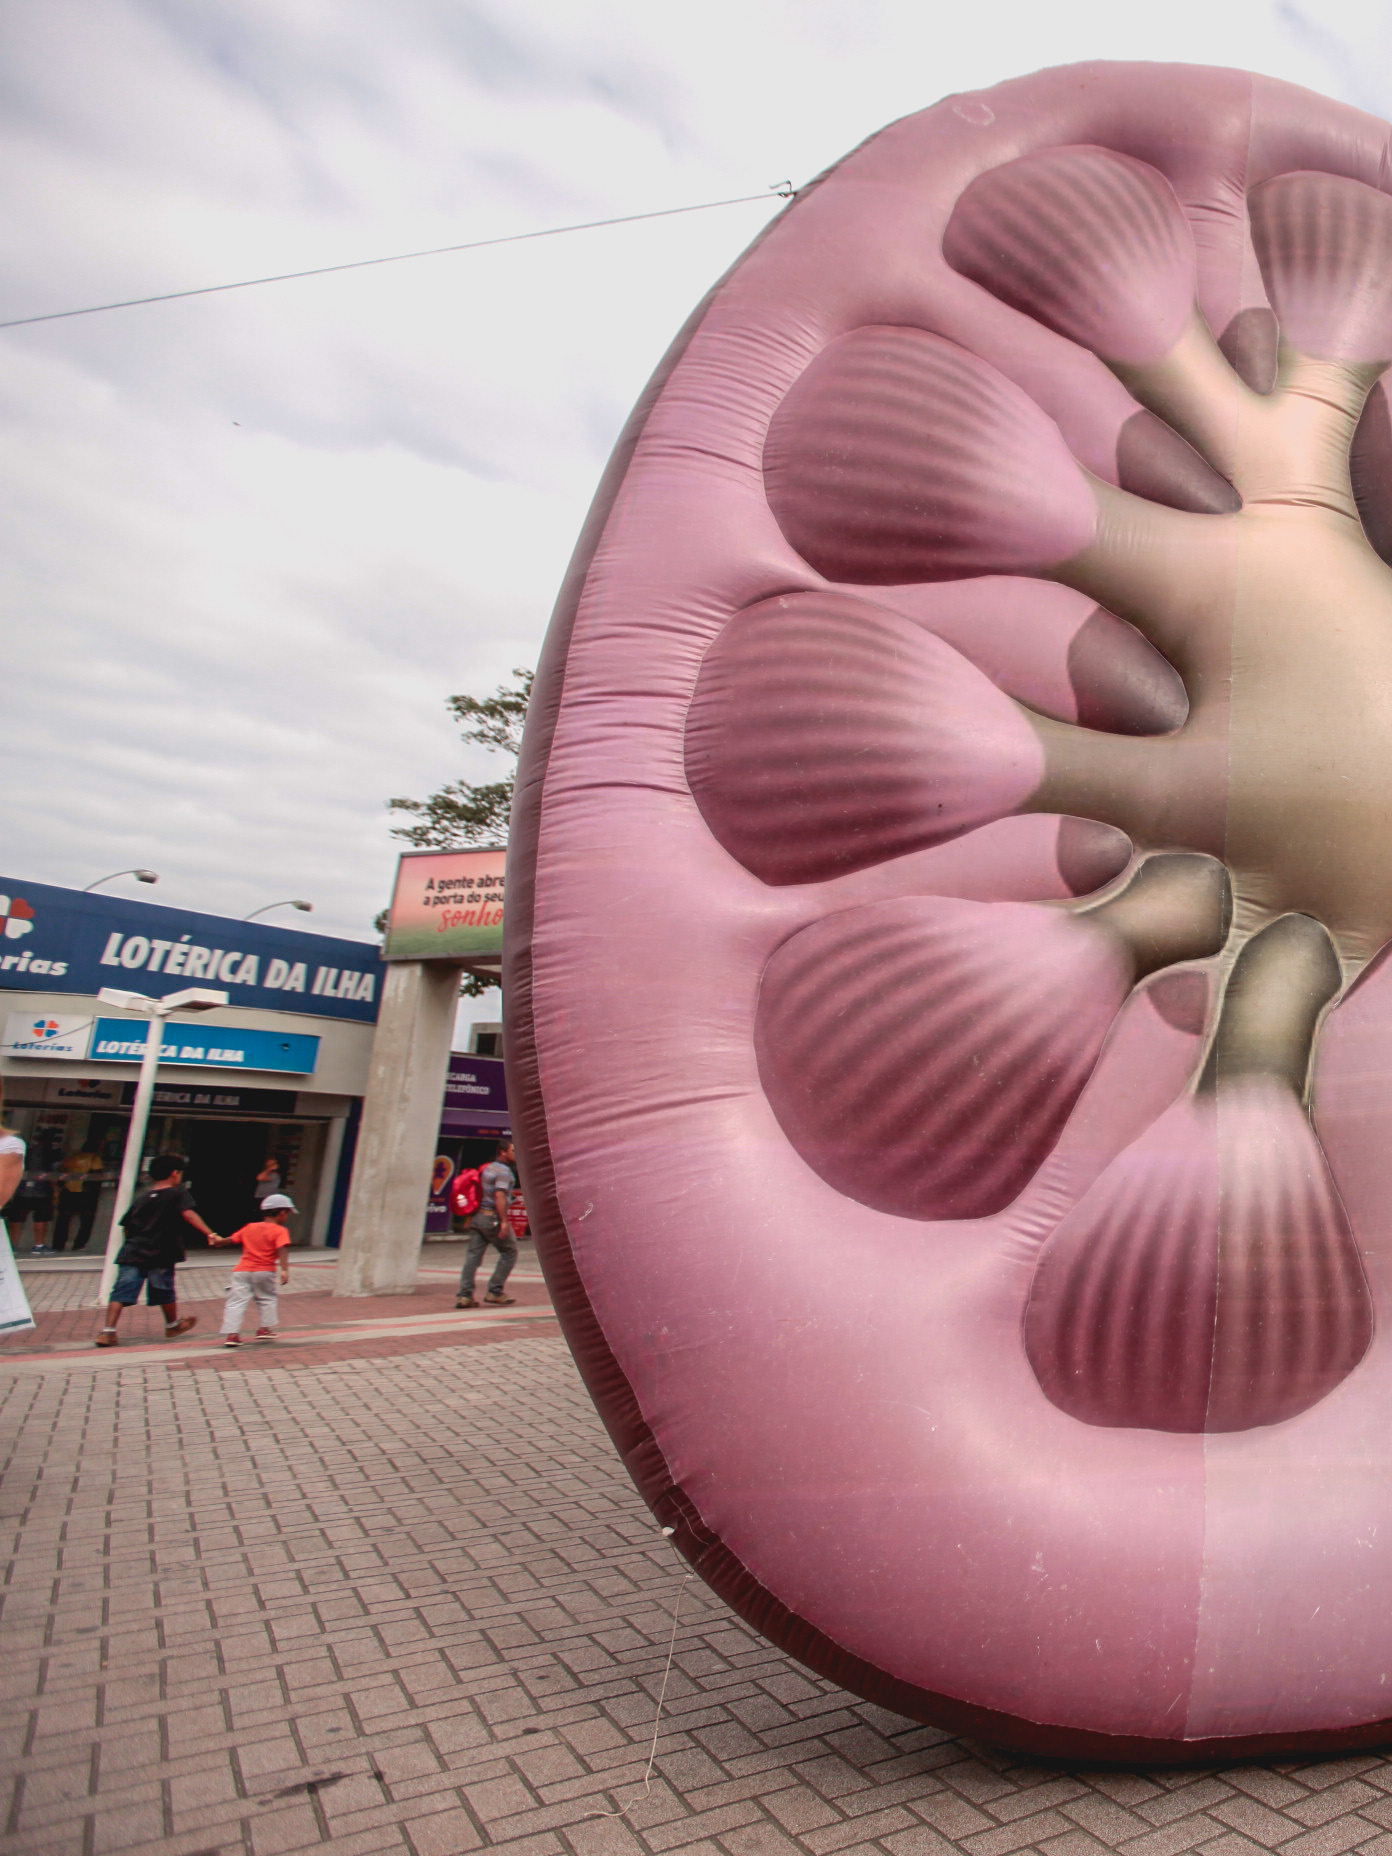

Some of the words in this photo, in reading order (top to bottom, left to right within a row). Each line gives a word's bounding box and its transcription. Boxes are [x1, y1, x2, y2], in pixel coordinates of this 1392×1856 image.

[425, 877, 435, 890] A
[437, 876, 474, 893] gente
[476, 875, 505, 888] abre
[423, 896, 431, 906] a
[432, 893, 464, 908] porta
[467, 892, 482, 903] do
[0, 951, 69, 976] rias
[100, 934, 260, 986] LOTÉRICA
[263, 958, 308, 993] DA
[311, 966, 376, 1002] ILHA
[96, 1040, 178, 1058] LOTÉCA
[180, 1046, 205, 1060] DA
[206, 1048, 245, 1063] ILHA
